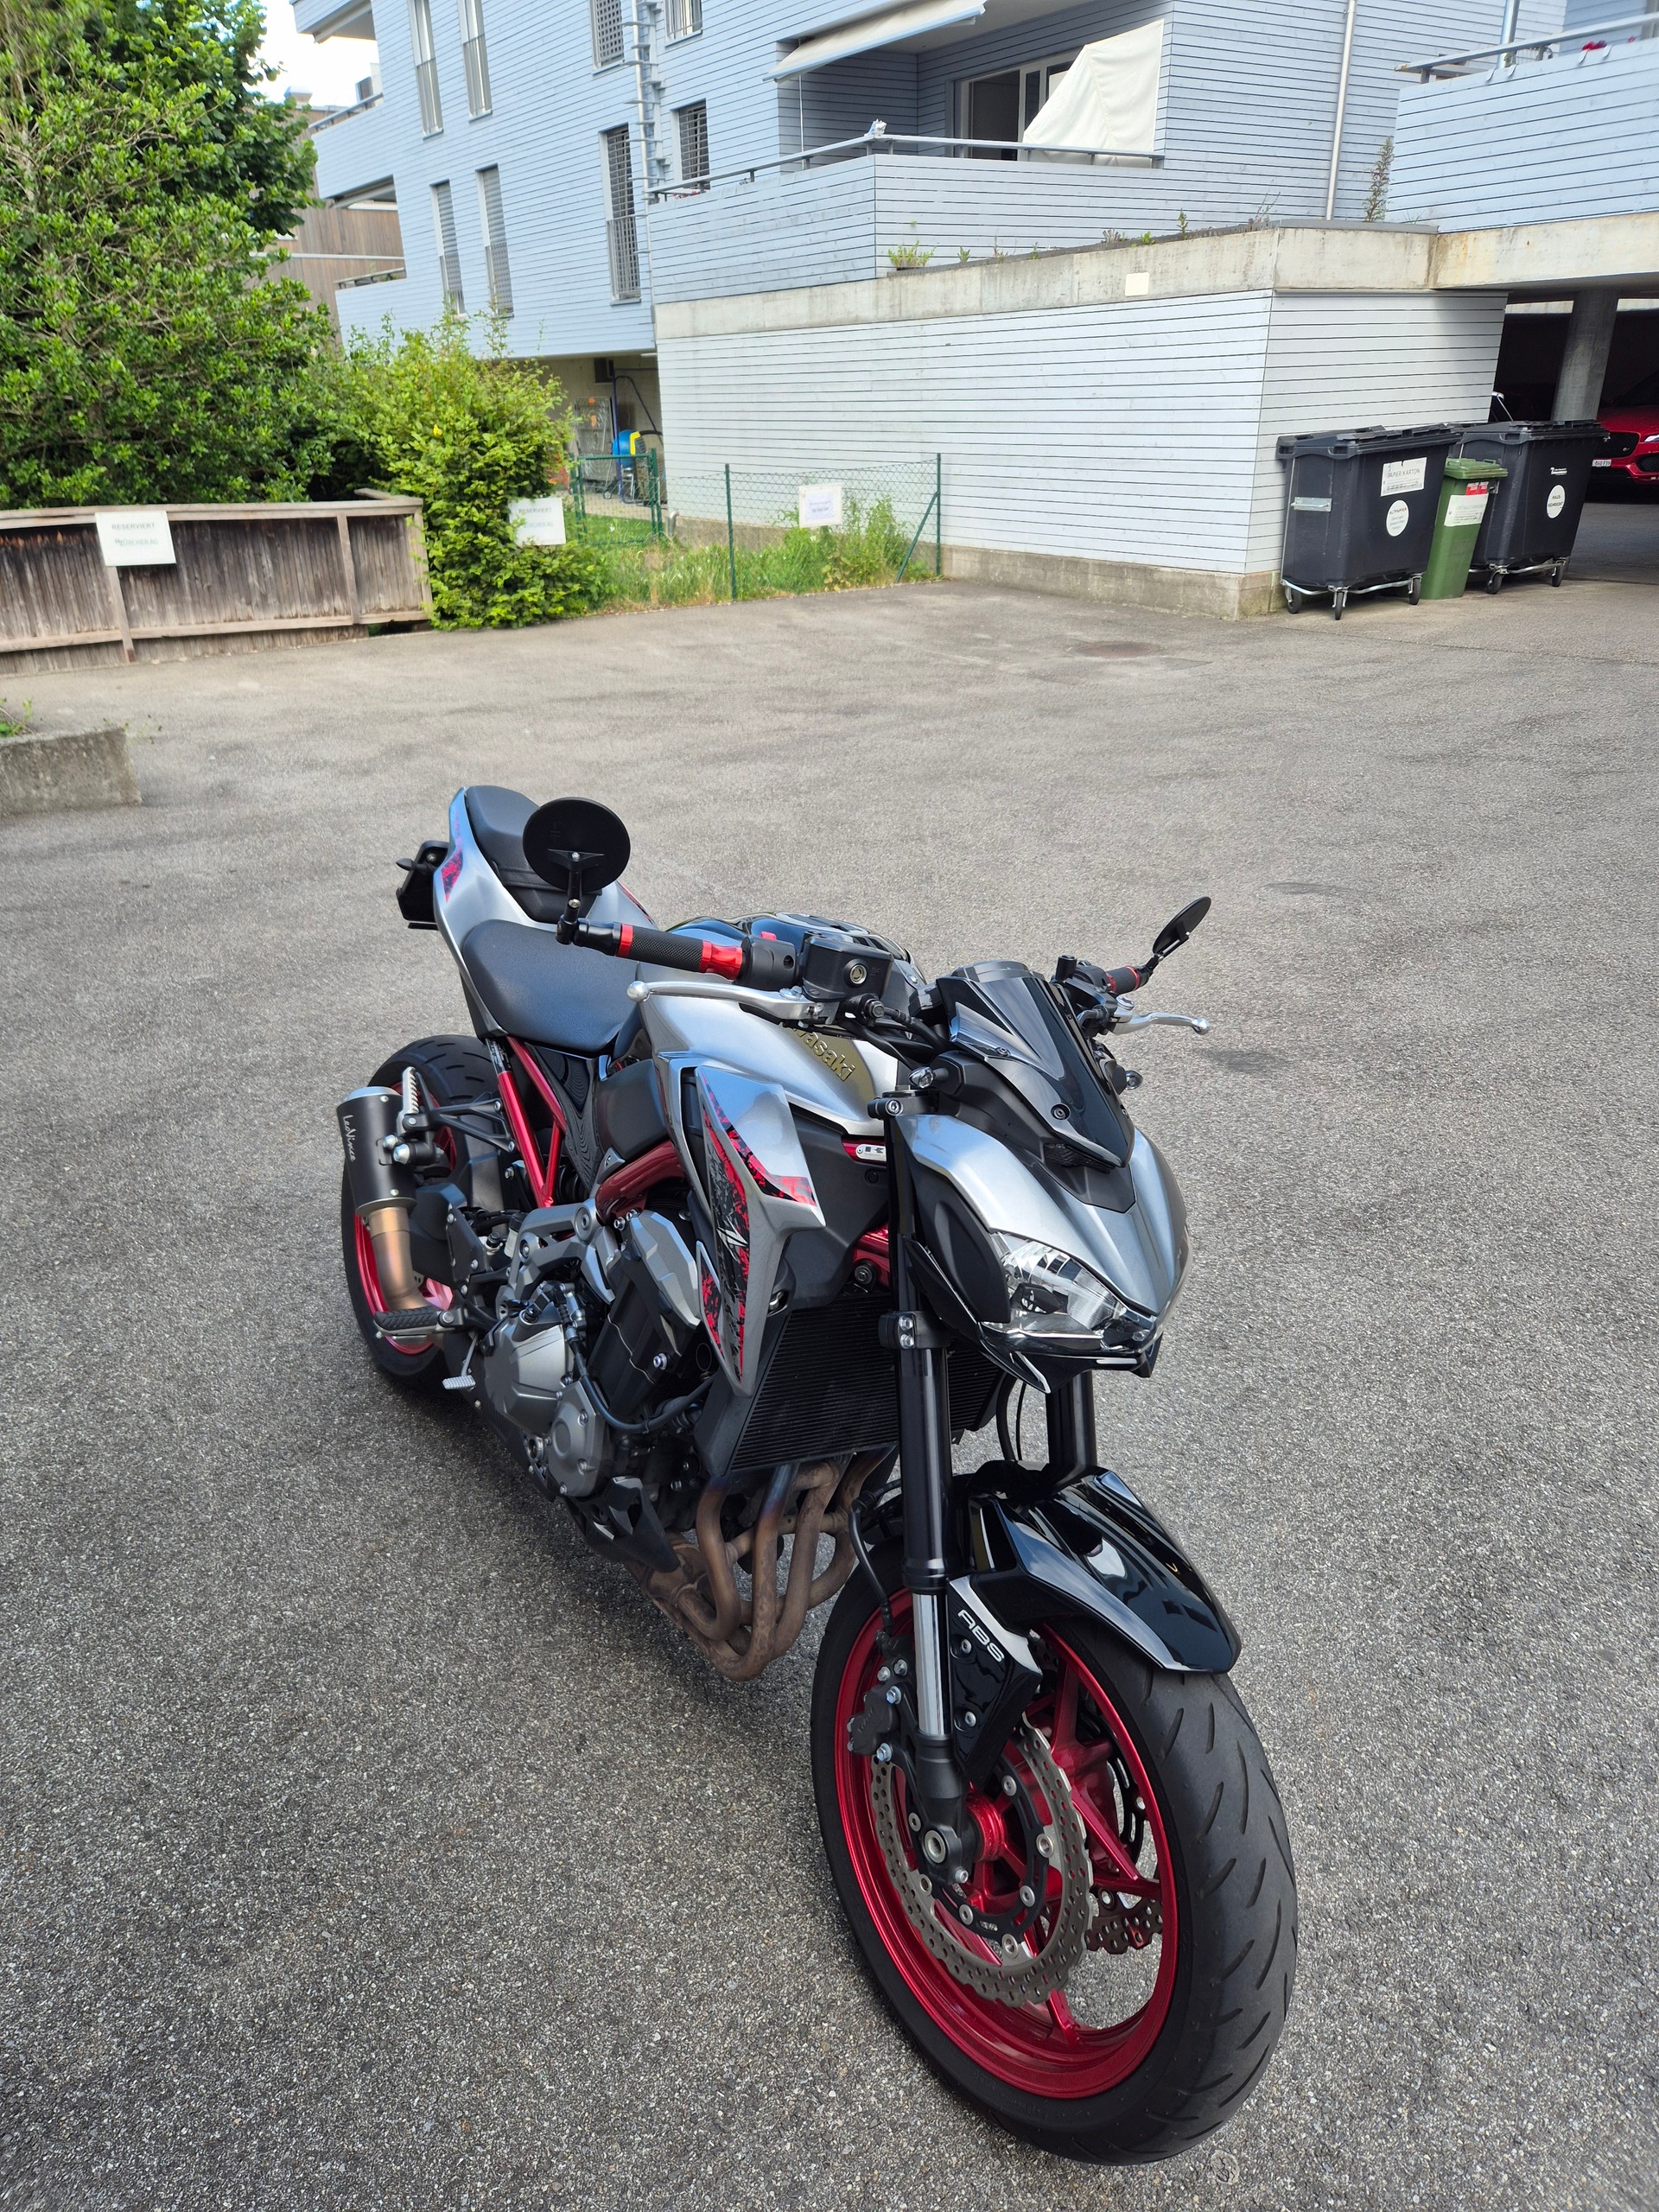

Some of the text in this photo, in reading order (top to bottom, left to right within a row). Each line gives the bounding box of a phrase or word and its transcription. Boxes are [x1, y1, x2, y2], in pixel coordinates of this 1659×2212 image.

[111, 522, 155, 531] RESERVIERT
[794, 1028, 855, 1082] asaki
[957, 1609, 1005, 1662] ABS
